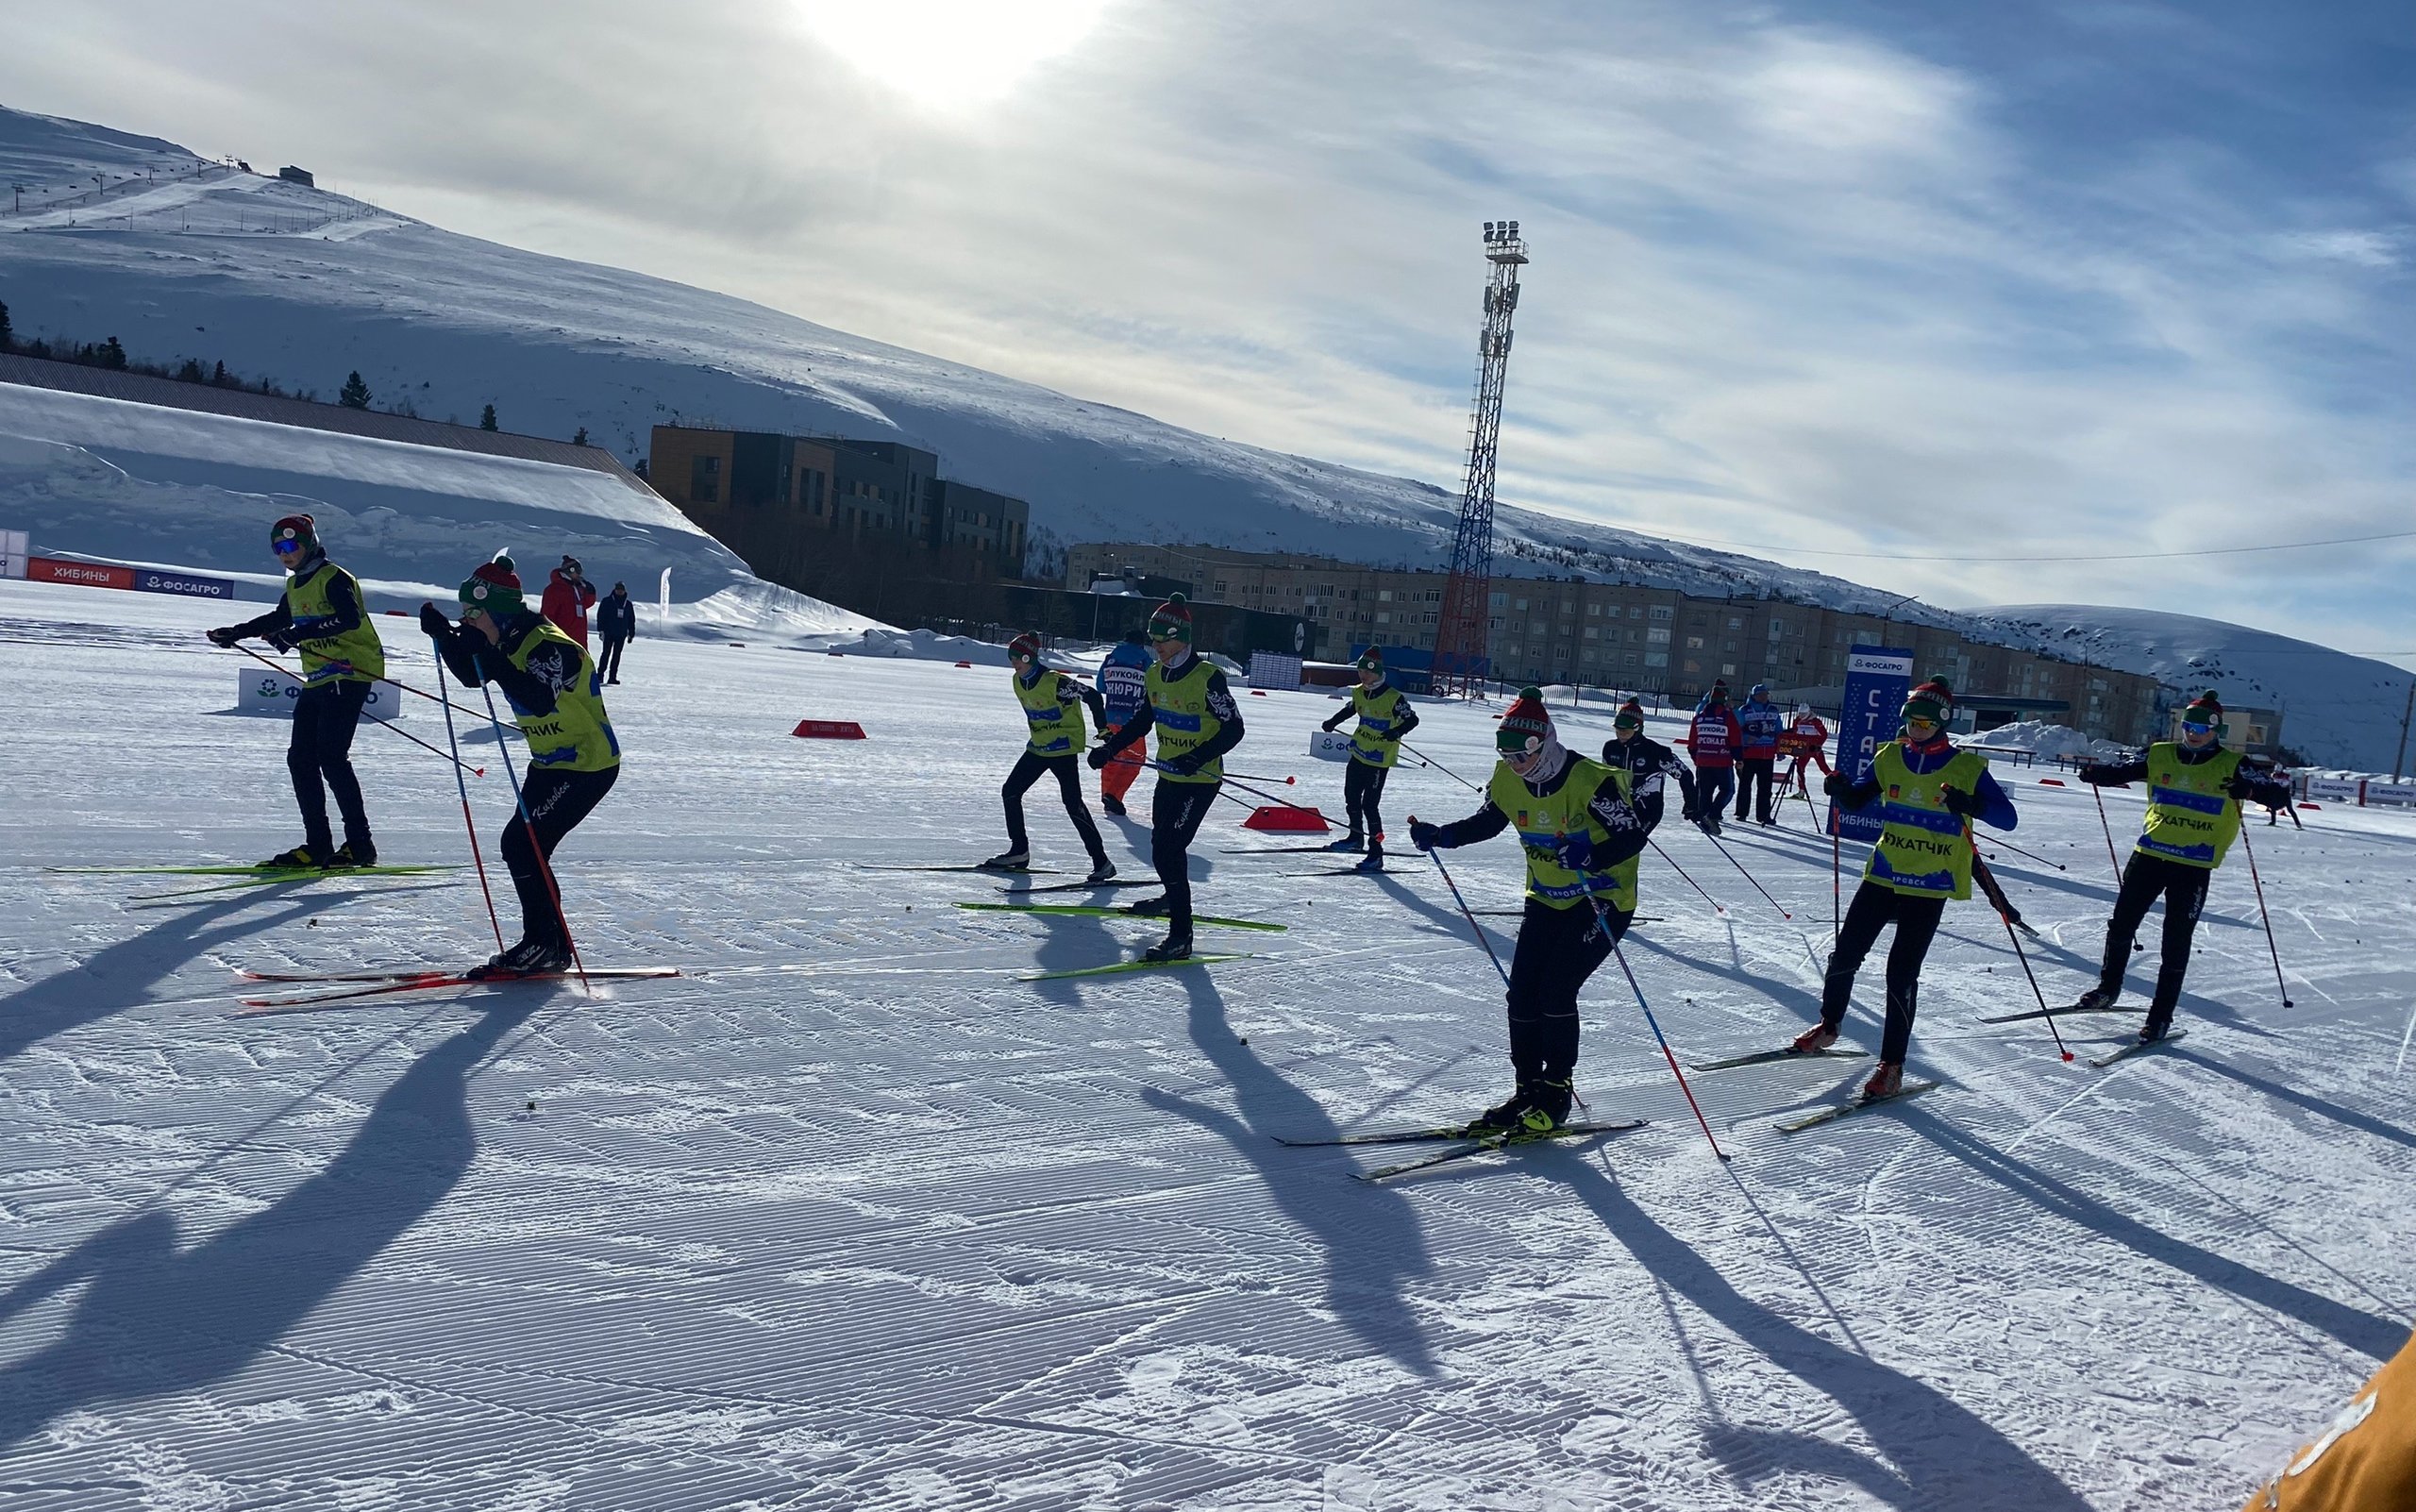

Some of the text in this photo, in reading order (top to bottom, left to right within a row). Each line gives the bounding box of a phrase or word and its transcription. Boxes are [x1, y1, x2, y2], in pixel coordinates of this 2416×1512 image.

[54, 567, 109, 582] ХИБИНЫ
[163, 580, 220, 595] ФОСАГРО
[1865, 663, 1903, 671] ФОСАГРО
[1106, 682, 1141, 697] ЖЮРИ
